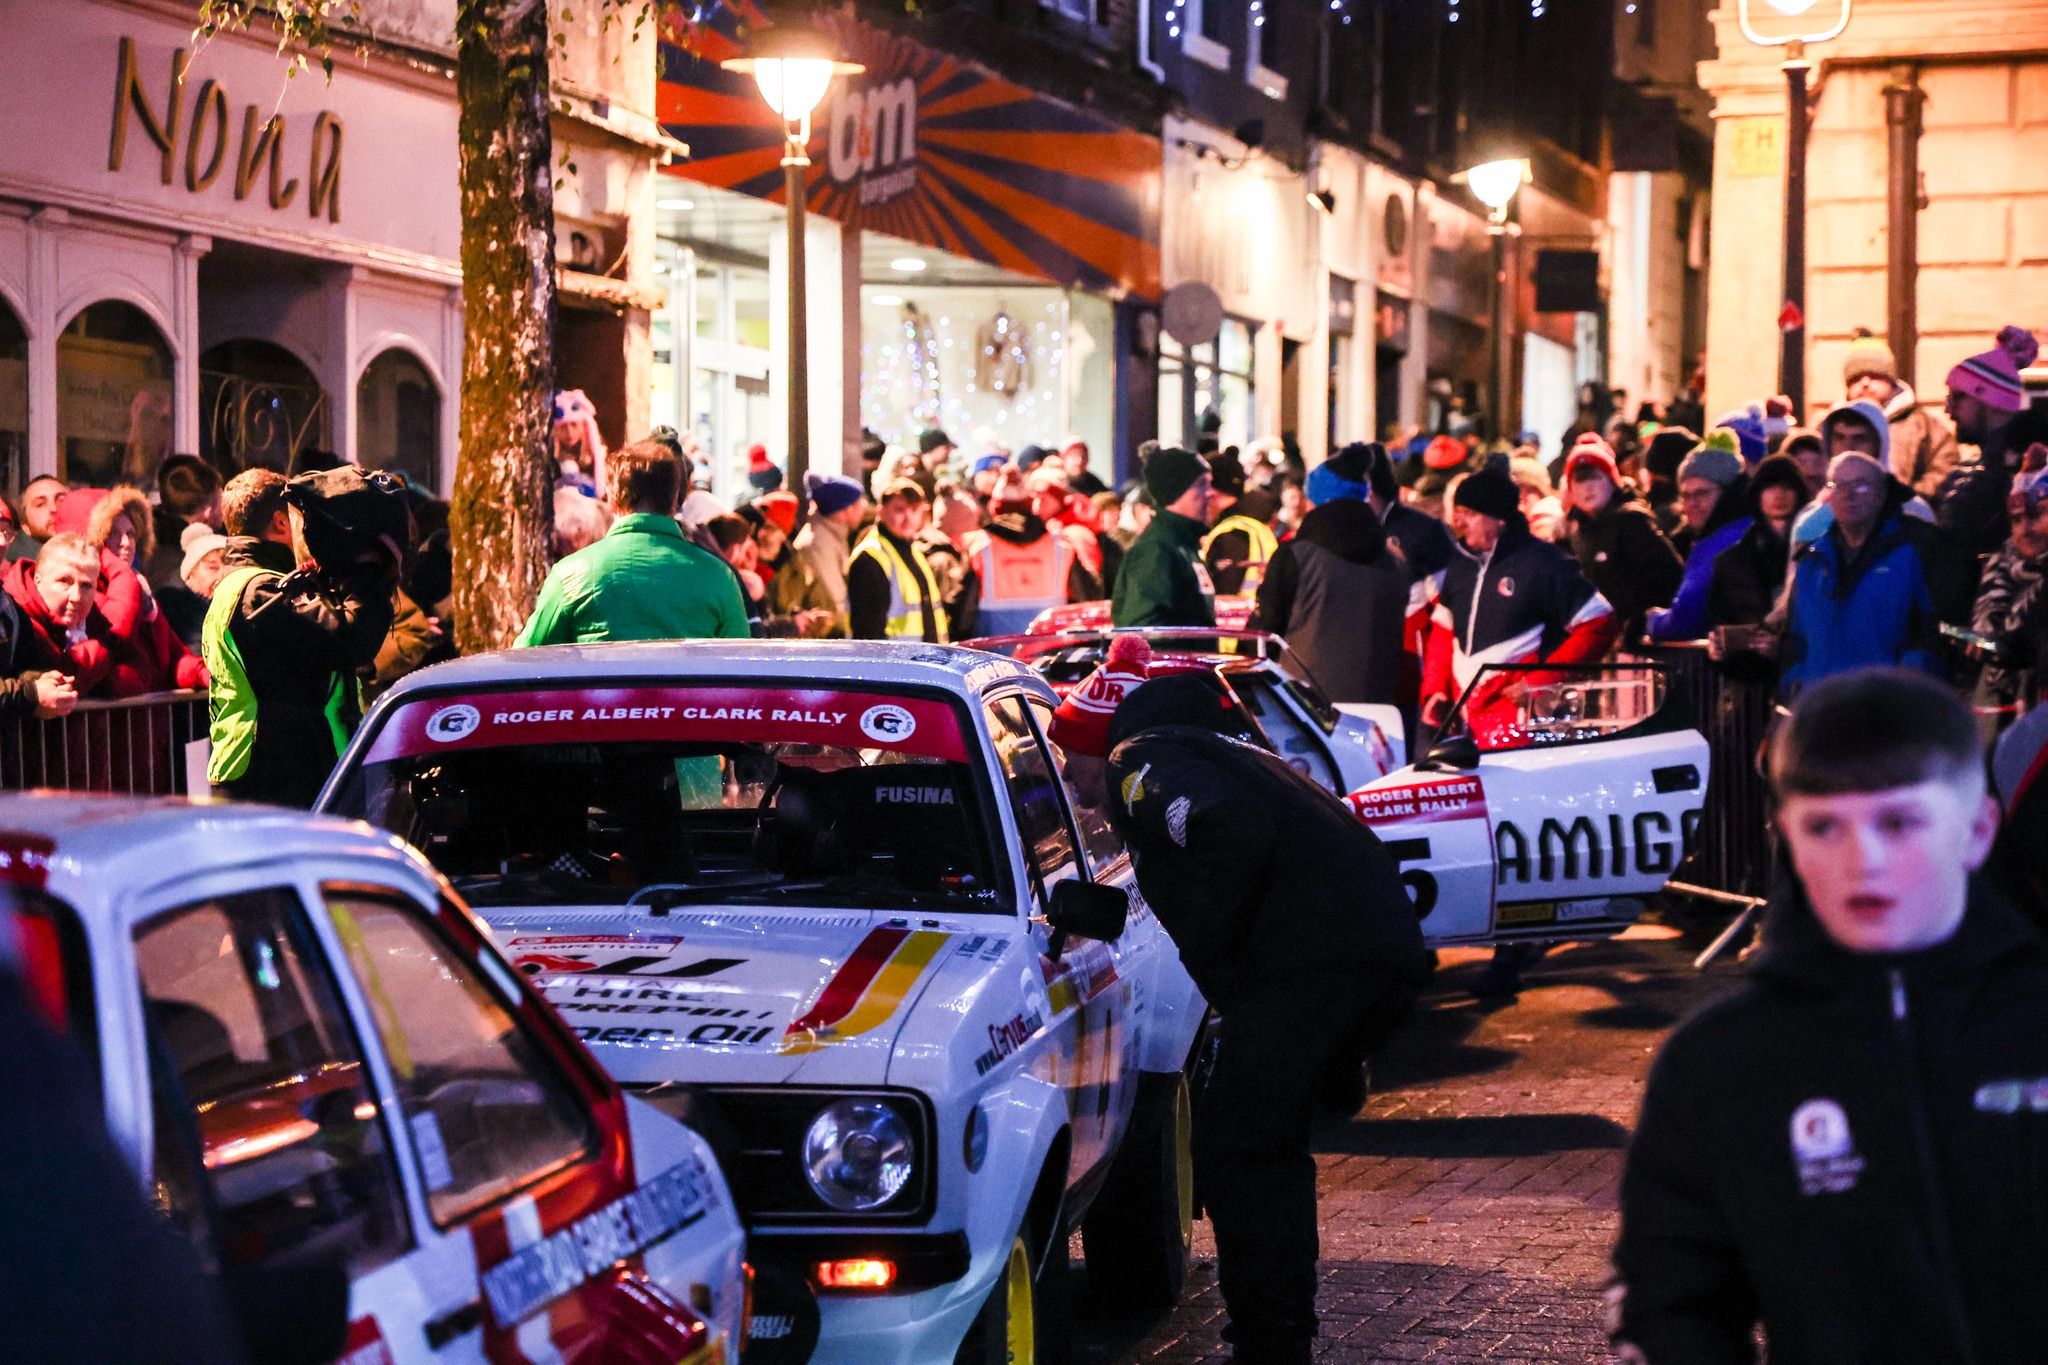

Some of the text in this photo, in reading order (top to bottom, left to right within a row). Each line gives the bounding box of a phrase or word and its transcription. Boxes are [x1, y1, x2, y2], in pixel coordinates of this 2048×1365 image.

[493, 707, 848, 724] ROGER ALBERT CLARK RALLY
[875, 787, 954, 804] FUSINA
[1359, 782, 1477, 804] ROGER ALBERT
[1363, 798, 1468, 818] CLARK RALLY
[516, 943, 660, 951] COMPETITOR
[574, 988, 703, 1002] HIRE
[688, 1024, 774, 1045] Oil
